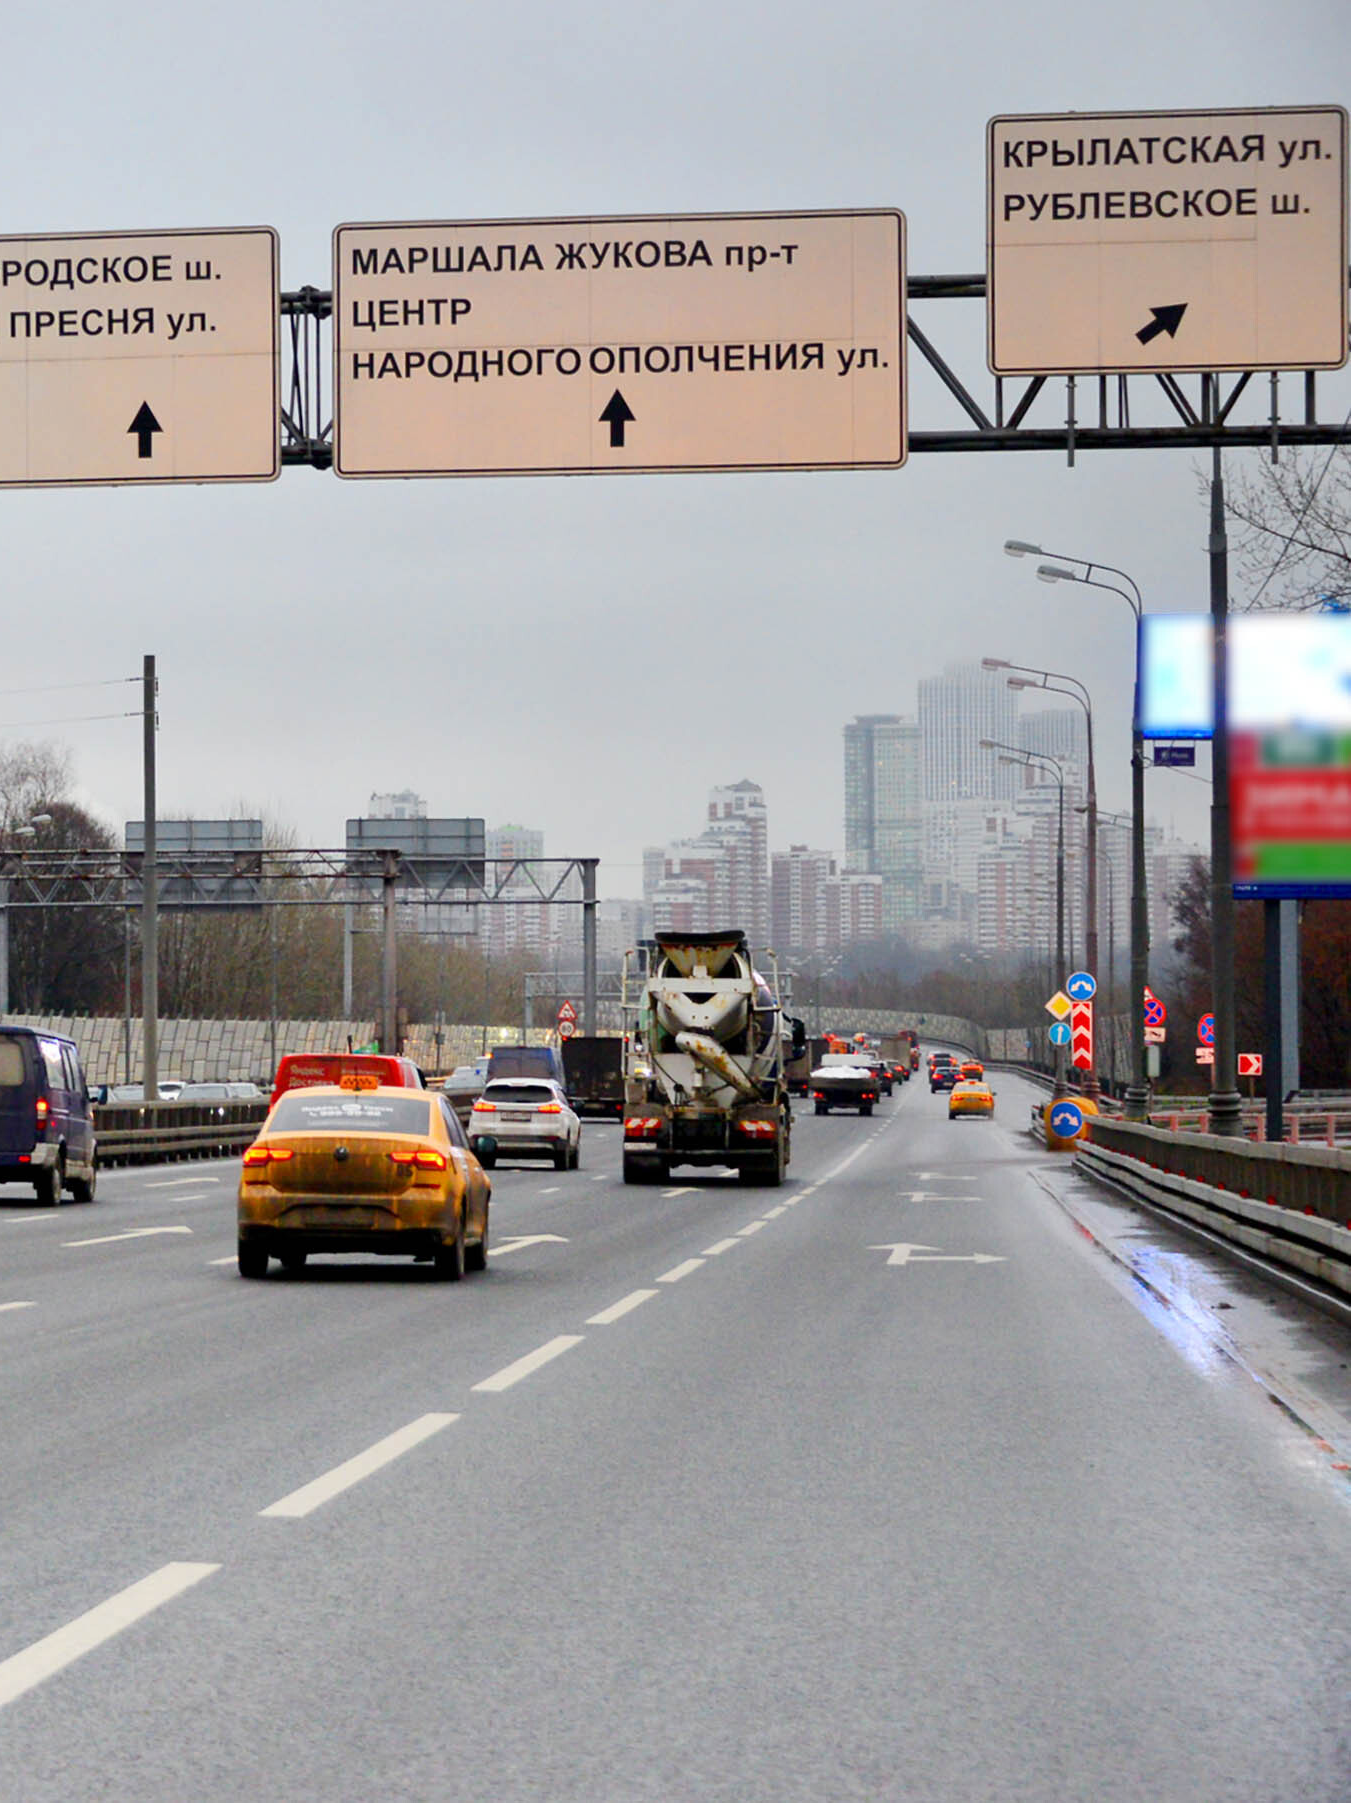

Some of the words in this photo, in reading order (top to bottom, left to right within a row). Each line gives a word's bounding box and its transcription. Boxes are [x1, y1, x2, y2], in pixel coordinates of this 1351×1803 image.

[1003, 134, 1265, 169] КРЫЛАТСКАЯ
[1277, 139, 1332, 169] ул.
[1004, 187, 1258, 222] РУБЛЕВСКОЕ
[1271, 193, 1310, 215] ш.
[185, 260, 221, 282] ш.
[352, 244, 545, 275] МАРШАЛА
[555, 239, 713, 270] ЖУКОВА
[725, 241, 799, 273] пр-т
[10, 307, 155, 338] ПРЕСНЯ
[166, 312, 216, 340] ул.
[352, 298, 472, 333] ЦЕНТР
[352, 347, 582, 383] НАРОДНОГО
[589, 342, 824, 375] ОПОЛЧЕНИЯ
[836, 348, 889, 377] ул.
